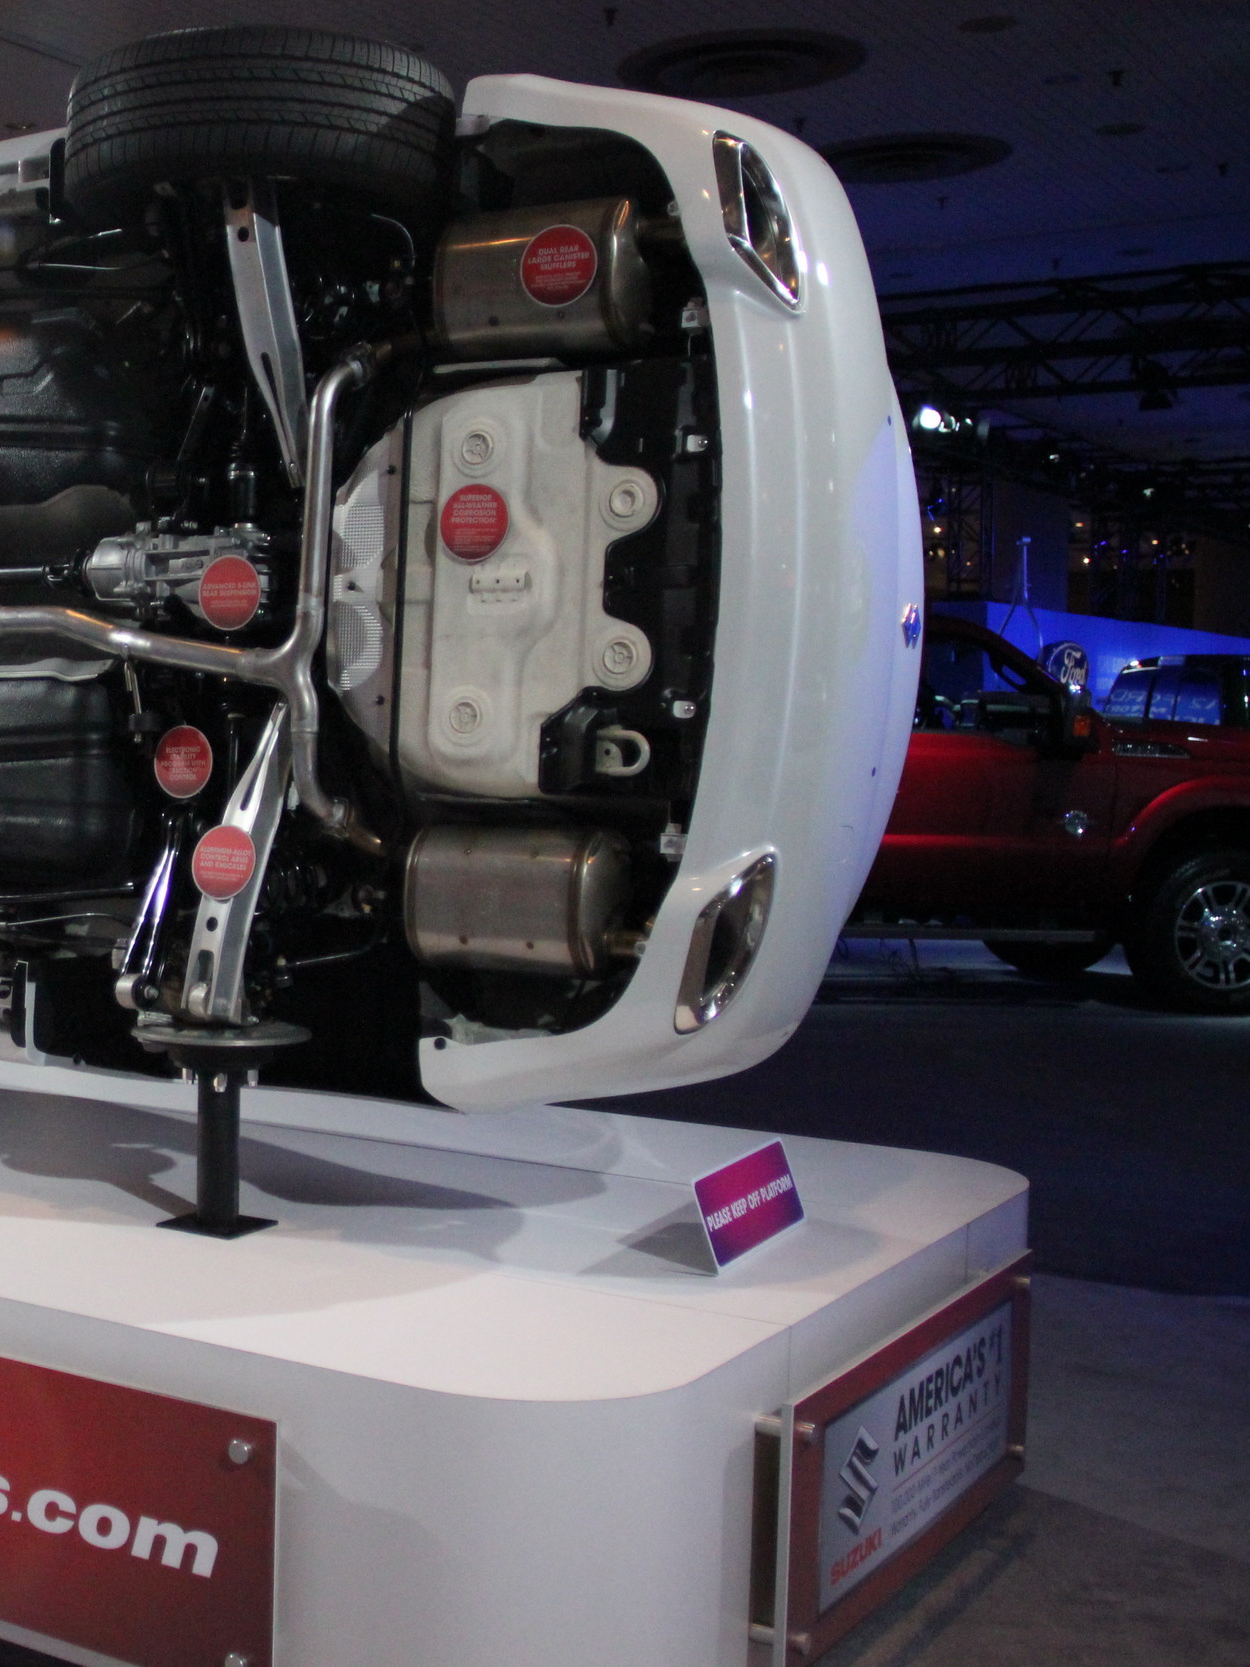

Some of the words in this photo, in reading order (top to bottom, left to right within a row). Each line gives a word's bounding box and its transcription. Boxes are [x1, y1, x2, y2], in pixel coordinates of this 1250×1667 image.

[541, 261, 576, 269] MUFFLERS
[553, 252, 590, 261] CANISTER
[1060, 648, 1087, 686] Ford
[707, 1206, 732, 1232] PLEASE
[730, 1198, 747, 1219] KEEP
[748, 1191, 760, 1210] OFF
[760, 1174, 794, 1203] PLATFORM
[894, 1336, 986, 1442] AMERICA'S
[893, 1373, 1002, 1477] WARRANTY
[830, 1527, 882, 1586] SUZUKI
